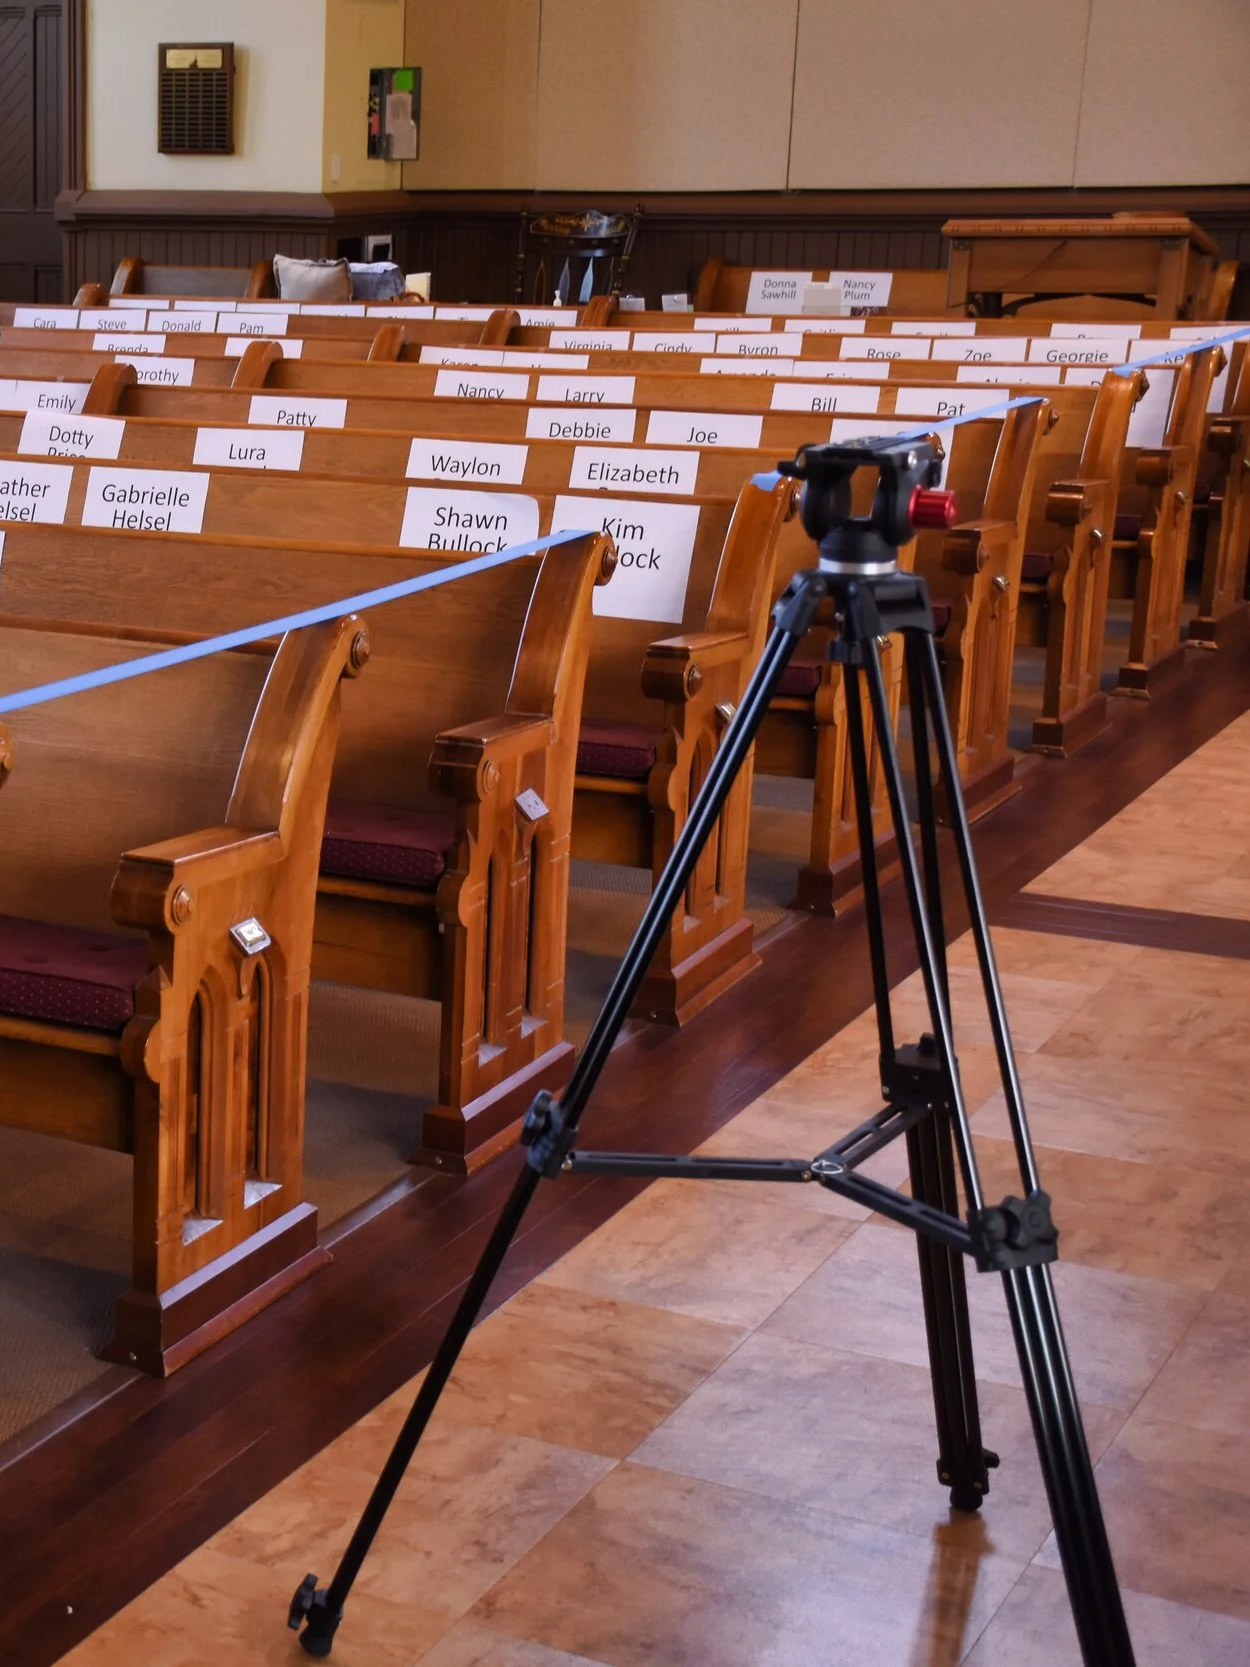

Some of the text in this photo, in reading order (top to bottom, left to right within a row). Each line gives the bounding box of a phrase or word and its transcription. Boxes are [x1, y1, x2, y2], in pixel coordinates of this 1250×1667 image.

[763, 279, 797, 289] Donna
[843, 279, 876, 291] Nancy
[761, 291, 797, 300] Sawhill
[844, 291, 871, 301] Plum
[33, 317, 57, 328] Cara
[98, 319, 127, 330] Steve
[161, 320, 202, 332] Donald
[239, 323, 264, 334] Pam
[107, 343, 148, 353] Brenda
[867, 348, 901, 359] Rose
[964, 350, 991, 361] Zoe
[1046, 350, 1108, 363] Georgie
[137, 368, 179, 385] orothy
[457, 383, 505, 399] Nancy
[565, 389, 605, 402] Larry
[37, 394, 77, 412] Emily
[811, 397, 837, 411] Bill
[937, 402, 965, 415] Pat
[277, 410, 316, 427] Patty
[49, 426, 94, 449] Dotty
[549, 423, 611, 439] Debbie
[687, 427, 717, 444] Joe
[229, 444, 266, 460] Lura
[431, 456, 501, 477] Waylon
[587, 463, 679, 484] Elizabeth
[102, 484, 190, 507] Gabrielle
[112, 510, 171, 531] Helsel
[433, 507, 507, 530] Shawn
[602, 518, 644, 541] Kim
[428, 533, 508, 553] Bullock
[616, 546, 661, 570] lock
